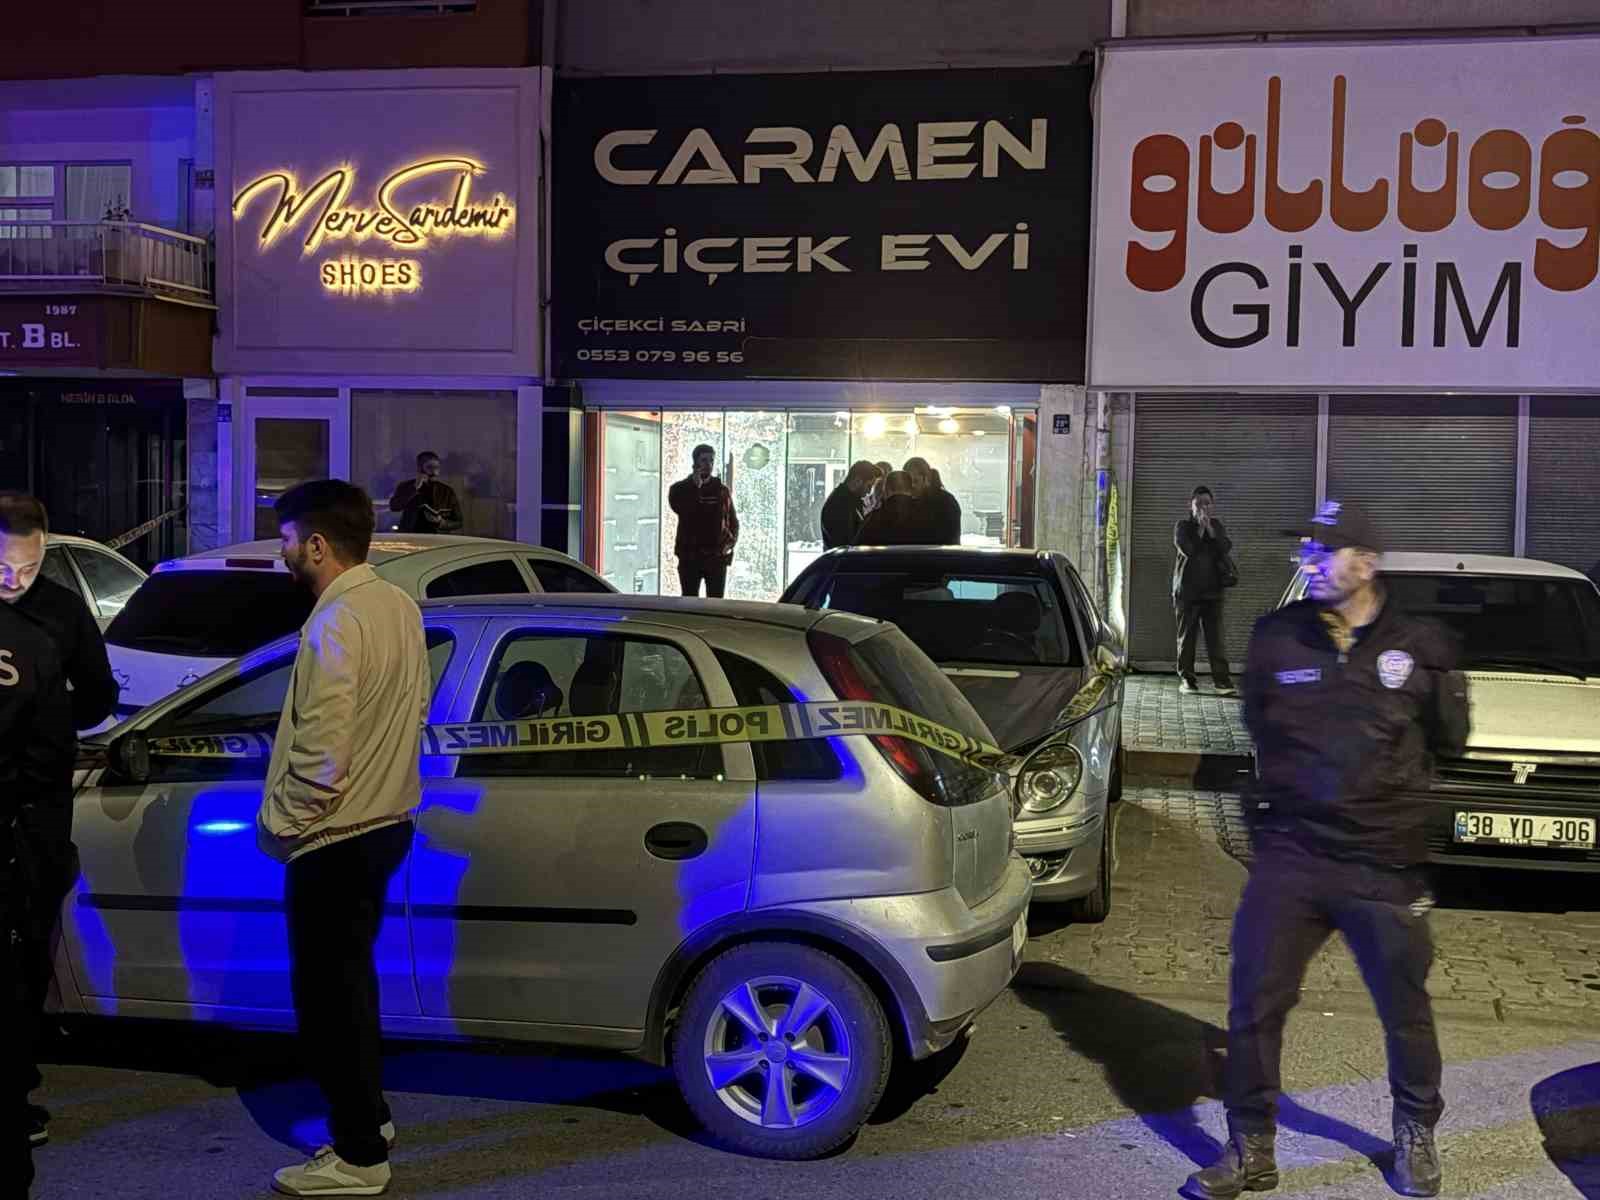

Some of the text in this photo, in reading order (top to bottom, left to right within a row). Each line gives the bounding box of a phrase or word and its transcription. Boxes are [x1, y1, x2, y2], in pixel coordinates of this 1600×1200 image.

[594, 118, 1048, 185] CARMEN
[604, 222, 1029, 287] ÇİÇEK EVİ
[322, 261, 413, 286] SHOES
[1190, 244, 1522, 349] GİYİM
[45, 305, 77, 316] 1987
[22, 323, 46, 348] B
[577, 316, 745, 336] ÇİÇEKCİ SABRİ
[577, 350, 744, 363] 0553 079 96 56
[0, 648, 20, 687] S
[1469, 815, 1493, 836] 38
[1509, 818, 1534, 839] YD
[1552, 820, 1590, 842] 306
